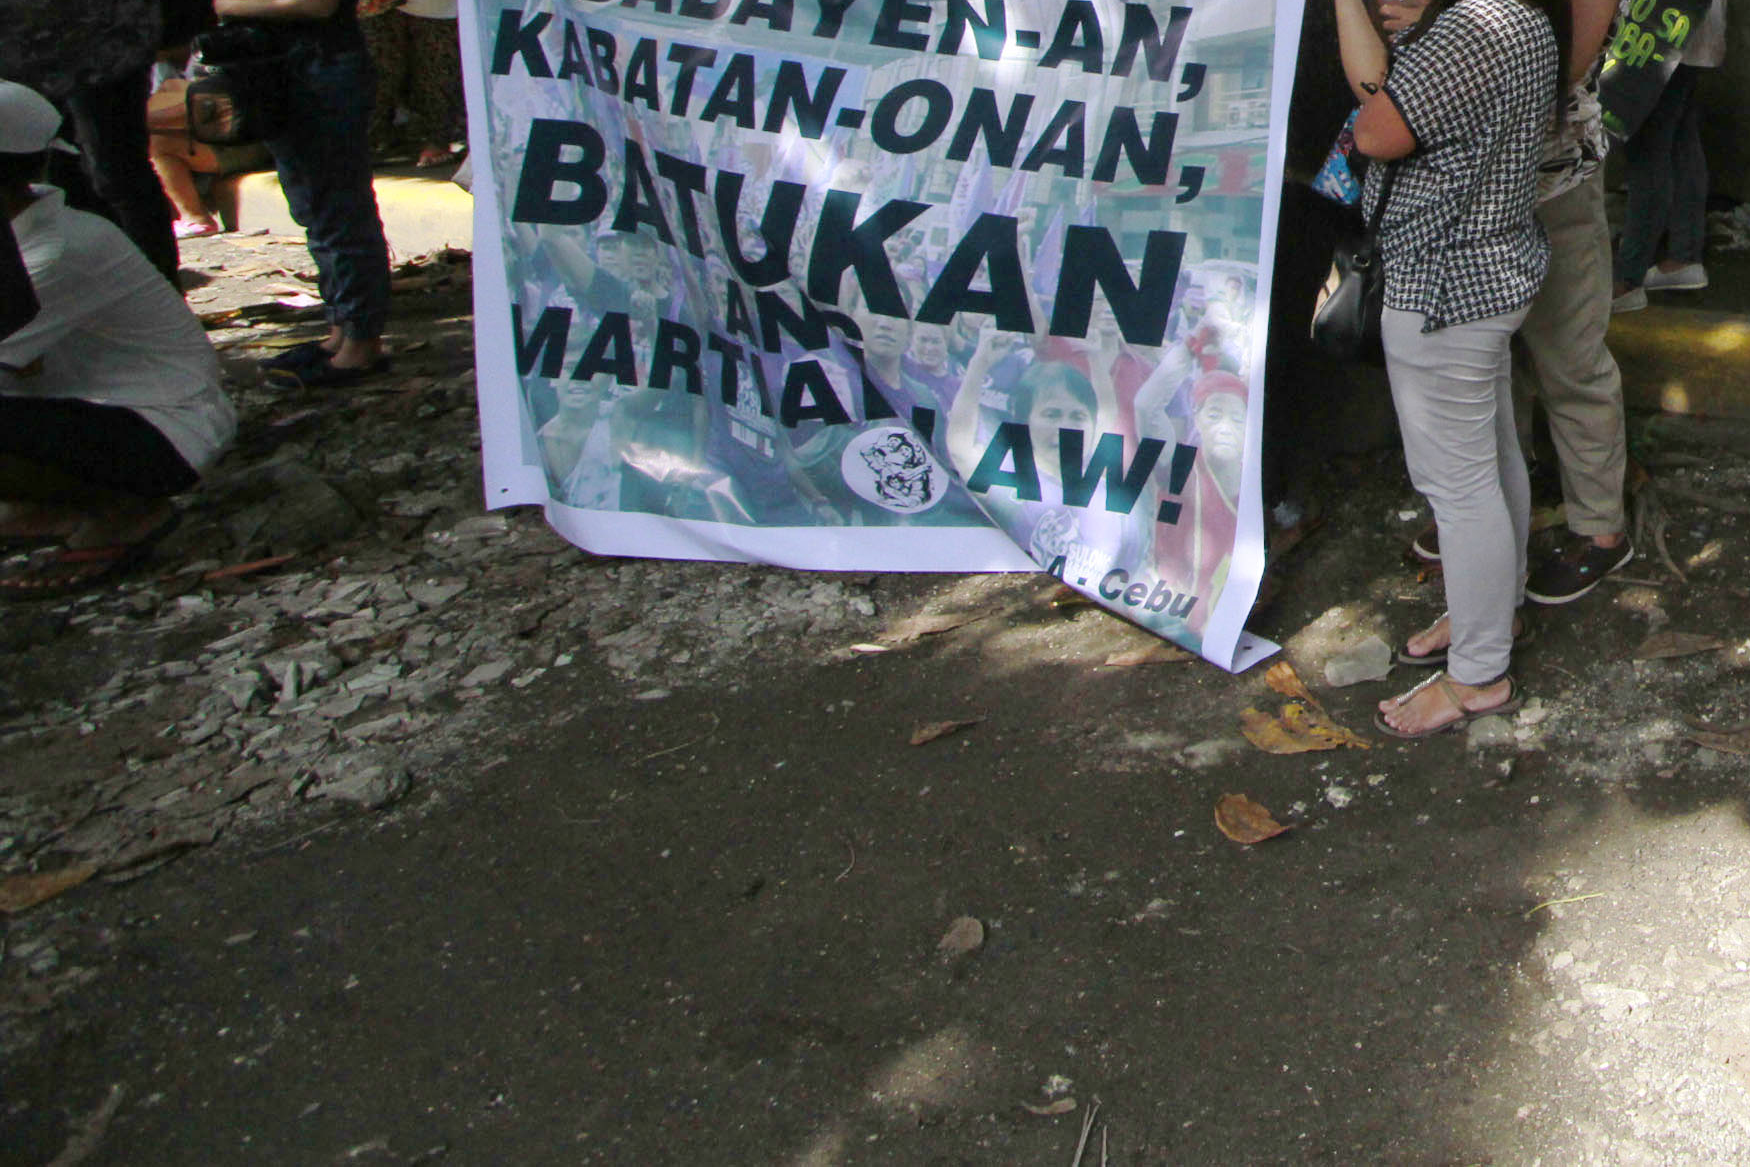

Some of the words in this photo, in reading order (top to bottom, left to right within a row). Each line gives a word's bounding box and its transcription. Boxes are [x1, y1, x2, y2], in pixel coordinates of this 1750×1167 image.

[490, 9, 1208, 204] KABATAN-ONAN,
[510, 119, 1187, 347] BATUKAN
[1098, 567, 1199, 619] Cebu
